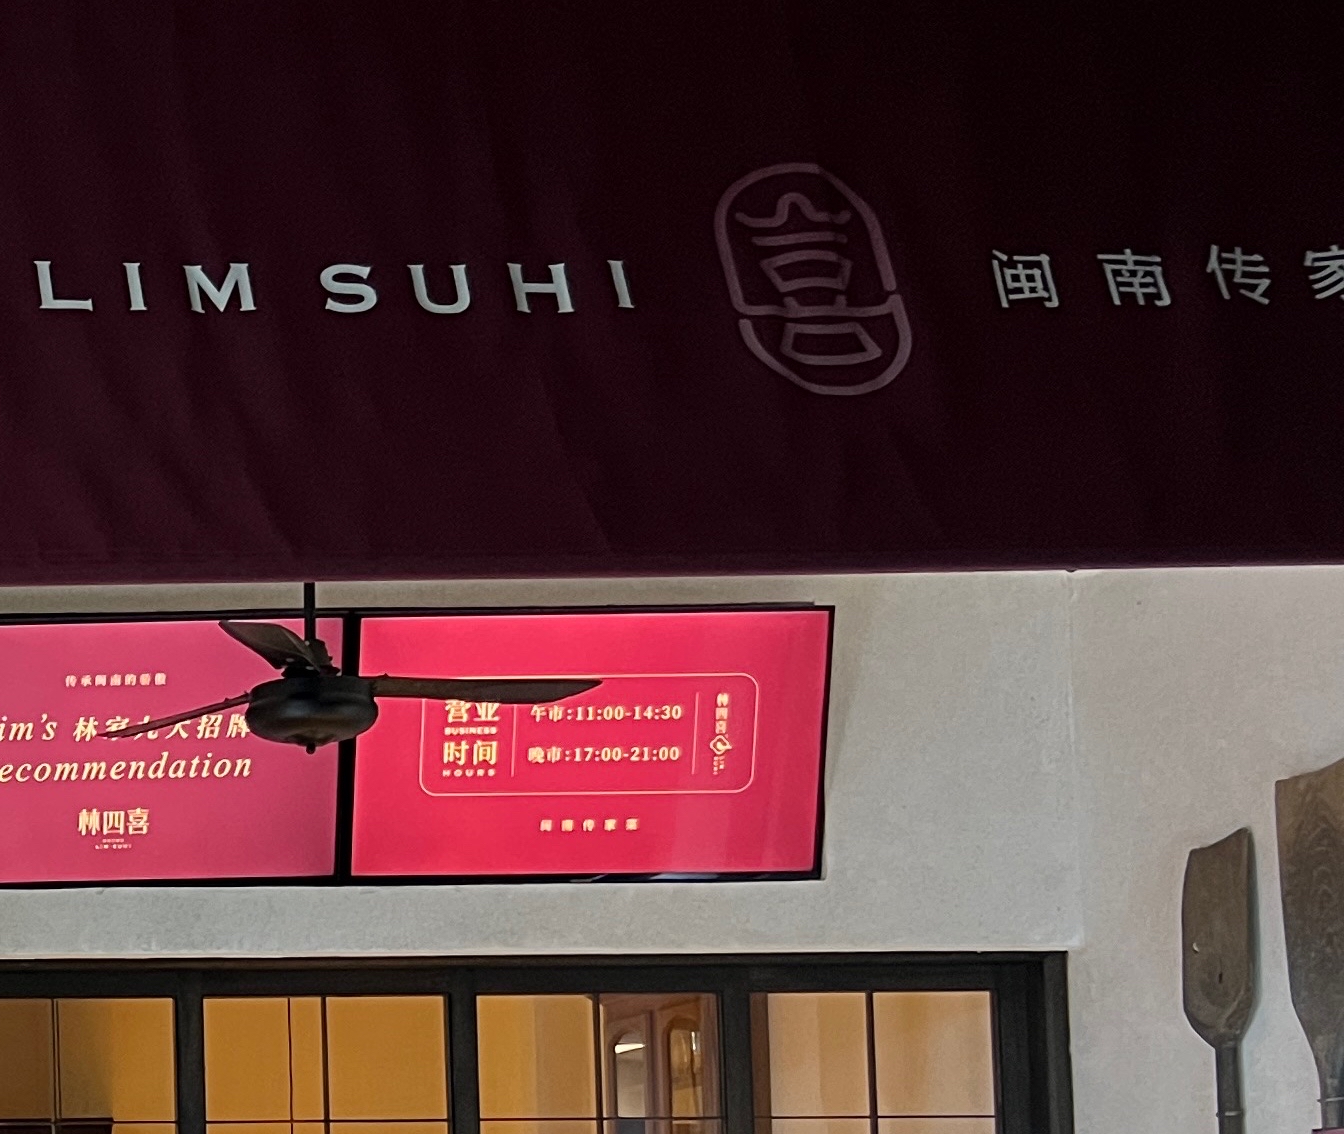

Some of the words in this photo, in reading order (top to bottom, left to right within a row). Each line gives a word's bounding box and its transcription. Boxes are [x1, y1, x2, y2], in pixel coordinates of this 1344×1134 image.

[32, 259, 258, 314] LIM
[319, 259, 637, 314] SUHI
[444, 699, 501, 723] 营业
[442, 740, 498, 767] 时间
[441, 768, 497, 778] HOURS
[77, 806, 151, 837] 林四喜
